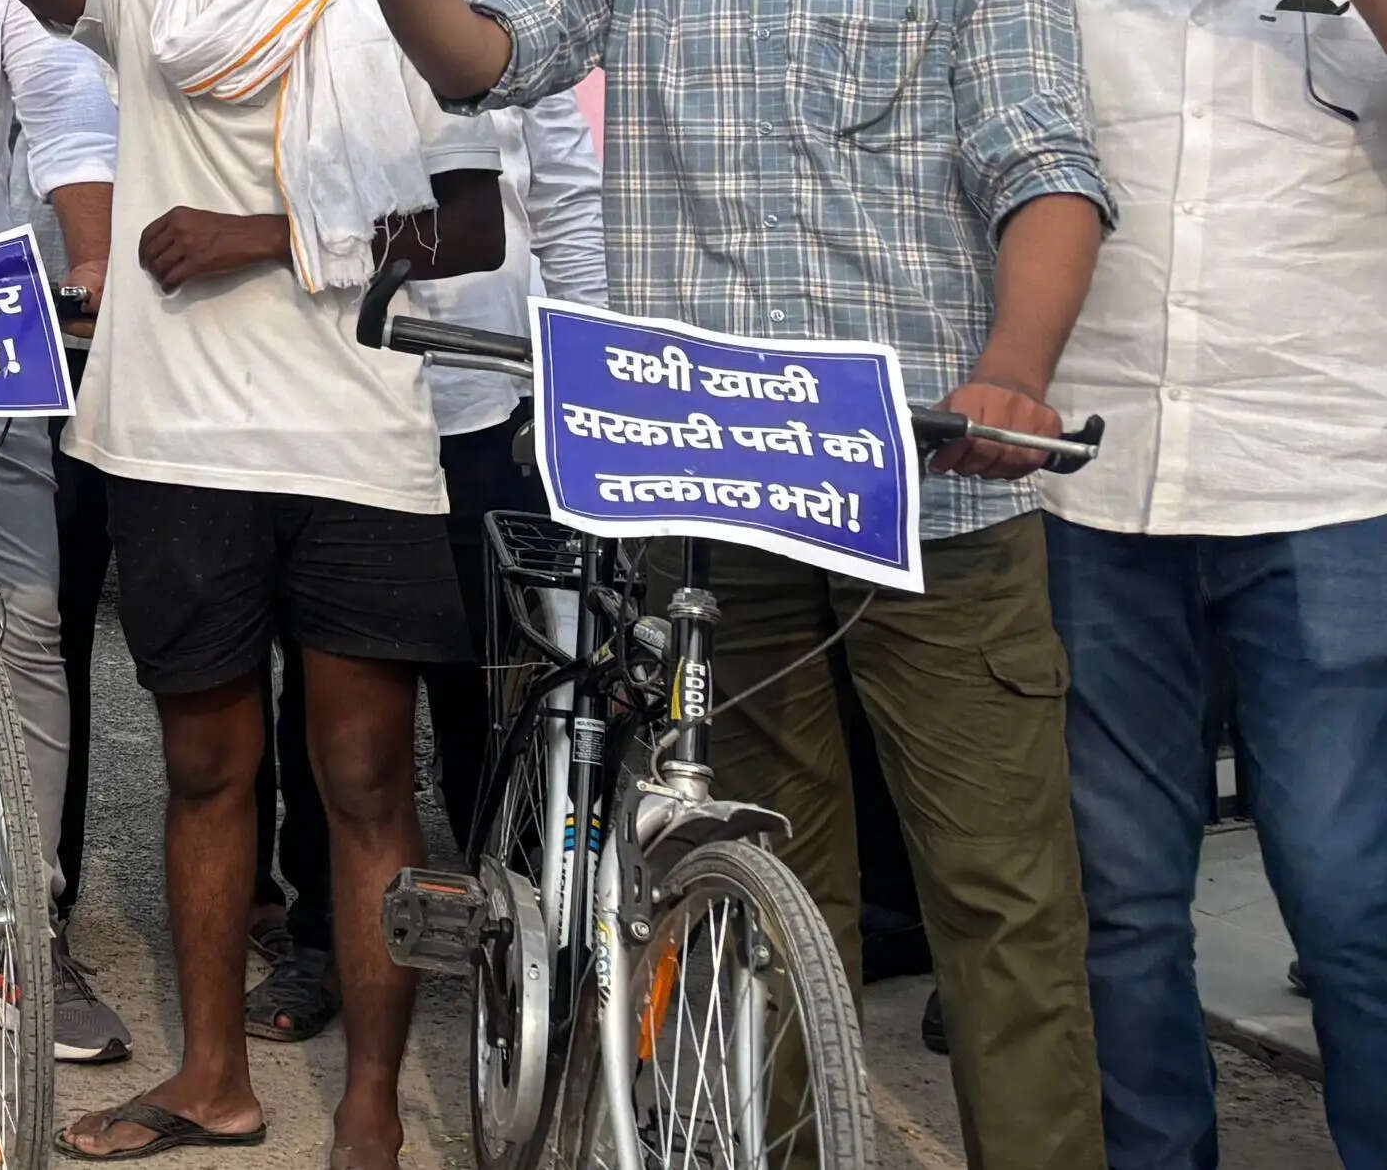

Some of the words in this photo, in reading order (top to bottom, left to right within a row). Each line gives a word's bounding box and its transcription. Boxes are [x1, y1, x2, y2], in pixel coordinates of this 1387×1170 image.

[605, 346, 694, 393] सभी
[699, 363, 820, 405] खाली
[562, 403, 724, 450] सरकारी
[727, 420, 814, 456] पदों
[818, 428, 885, 469] को
[594, 472, 763, 510] तत्काल
[766, 481, 861, 534] भरो!
[684, 662, 706, 717] ADDO
